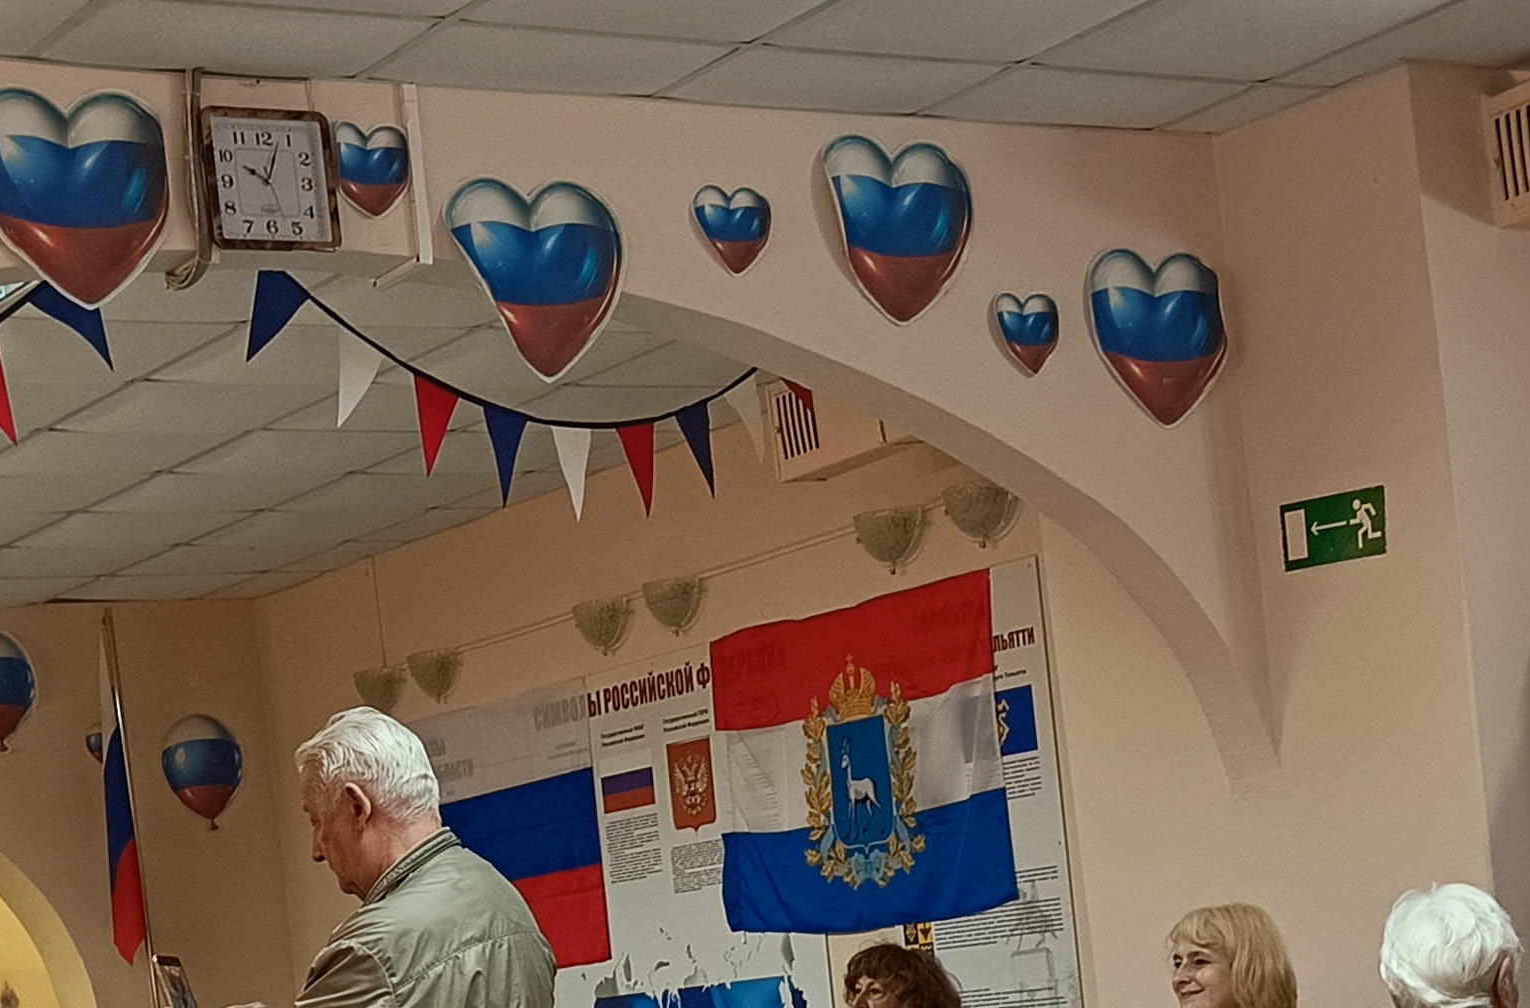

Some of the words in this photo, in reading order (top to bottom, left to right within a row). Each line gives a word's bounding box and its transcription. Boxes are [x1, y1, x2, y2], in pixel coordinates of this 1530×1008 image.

[233, 131, 245, 145] 11
[255, 131, 273, 146] 12
[286, 134, 291, 147] 1
[219, 150, 233, 163] 10
[299, 152, 311, 167] 2
[221, 174, 234, 189] 9
[301, 177, 313, 191] 3
[224, 201, 237, 216] 8
[303, 205, 315, 219] 4
[242, 220, 254, 234] 7
[266, 220, 279, 235] 6
[291, 222, 304, 235] 5
[604, 661, 694, 714] РОССИЙСКОЙ
